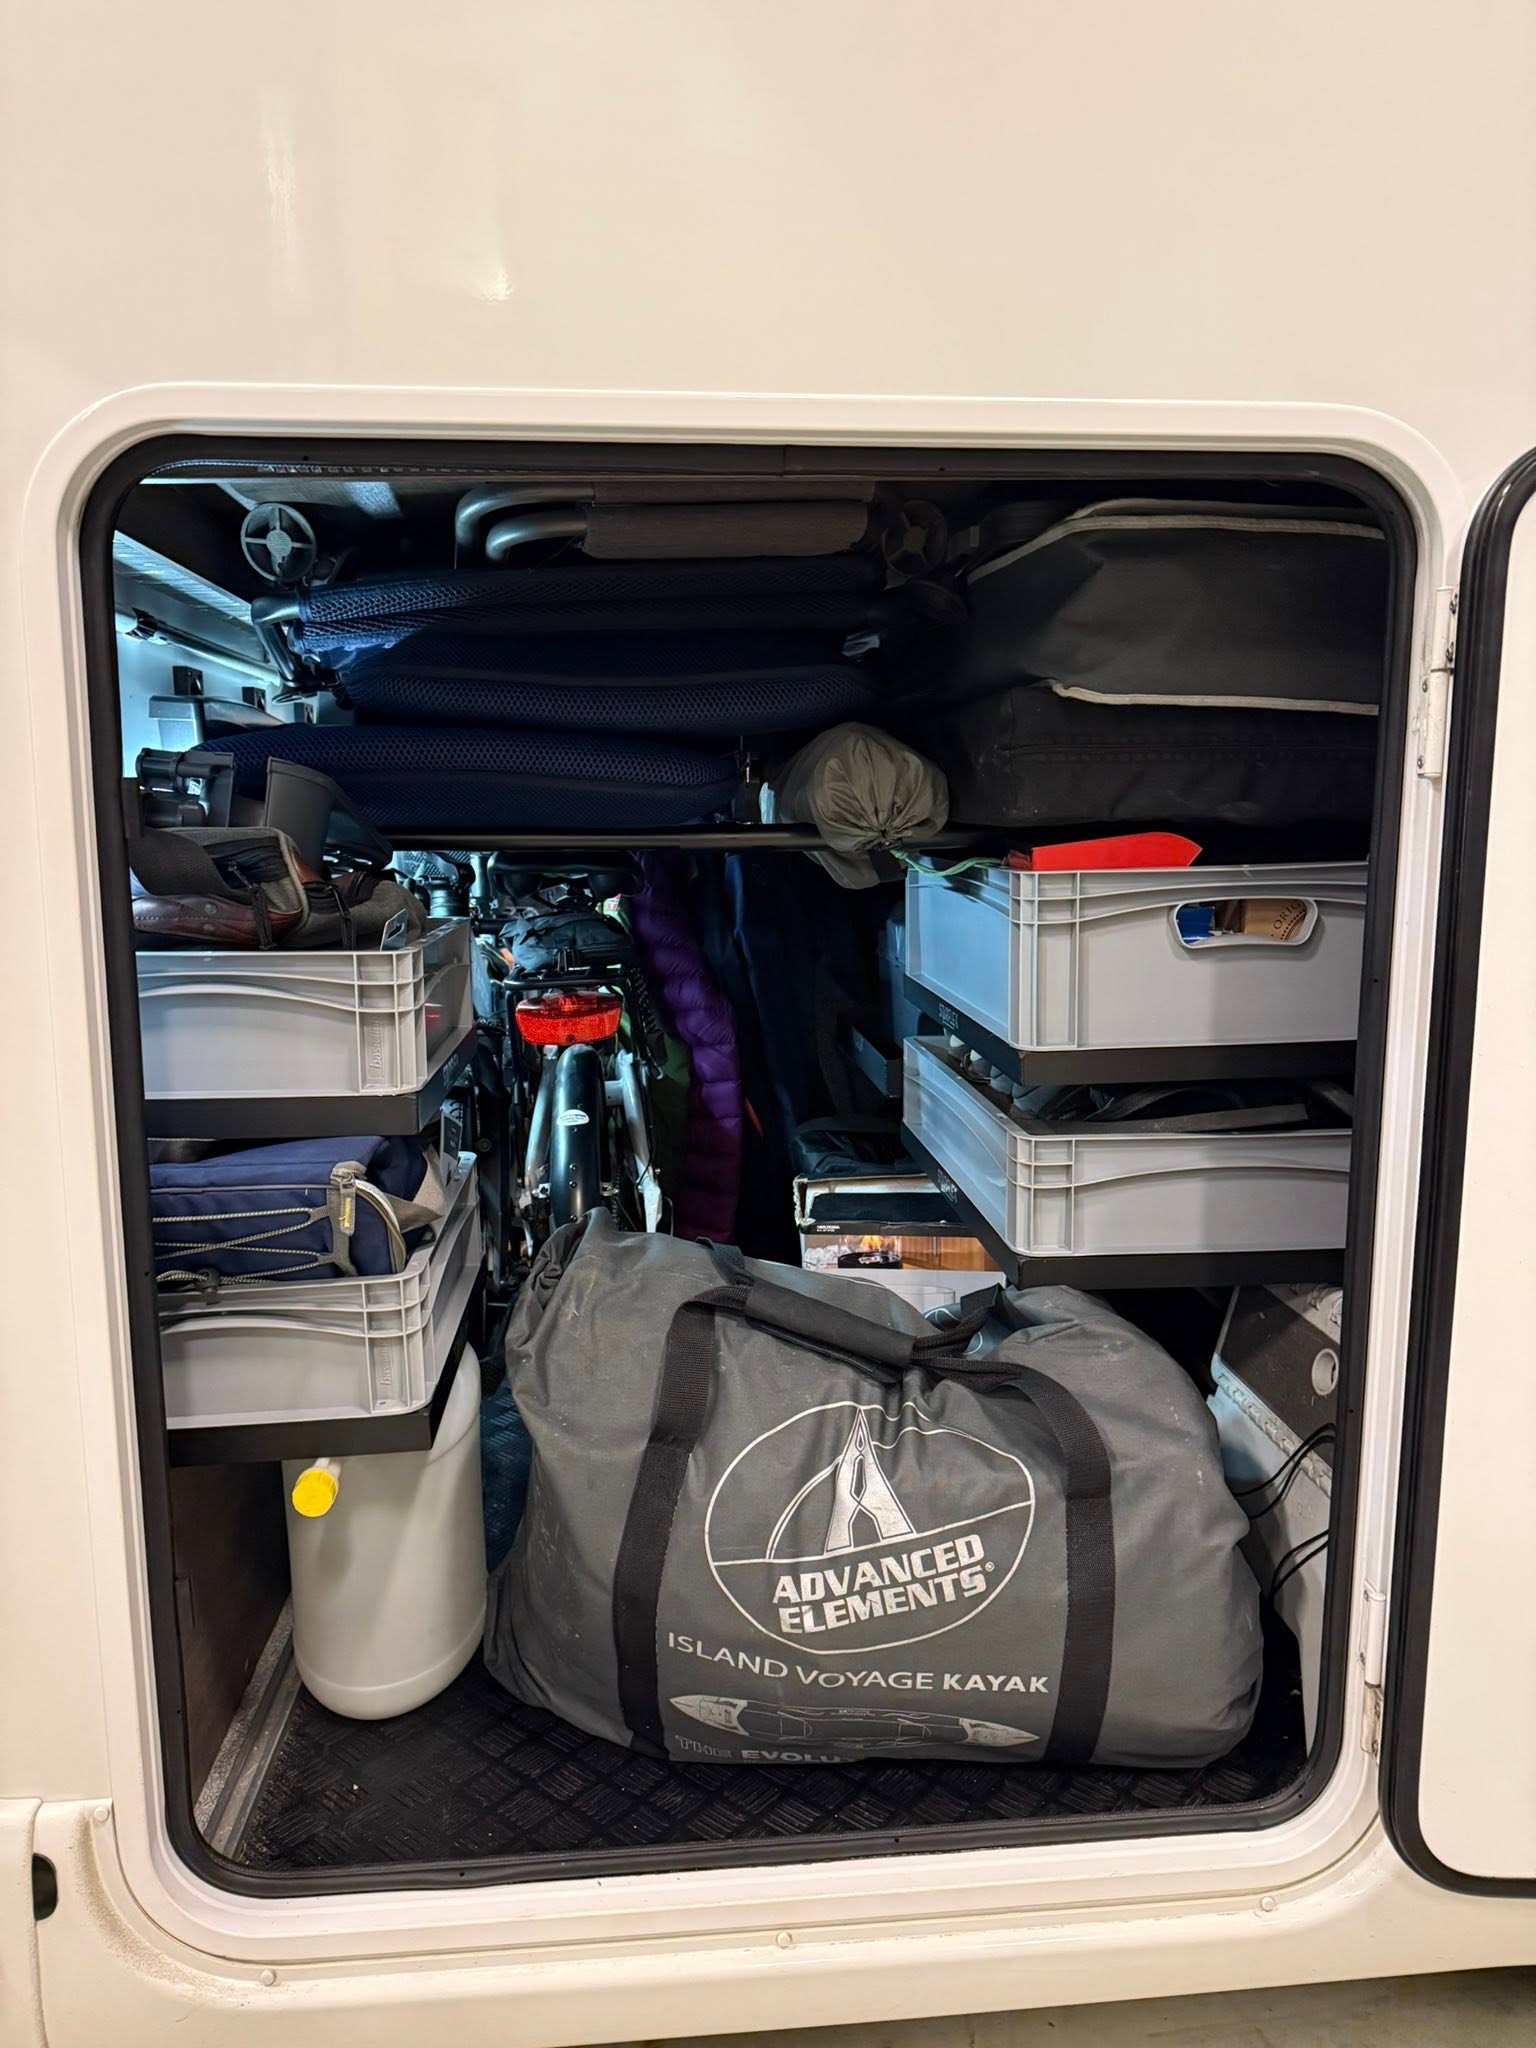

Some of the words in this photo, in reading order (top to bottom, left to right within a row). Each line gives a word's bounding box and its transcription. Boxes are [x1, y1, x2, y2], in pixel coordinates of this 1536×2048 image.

[772, 1534, 985, 1604] ADVANCED
[668, 1632, 788, 1678] ISLAND
[796, 1665, 934, 1690] VOYAGE
[943, 1673, 1049, 1693] KAYAK
